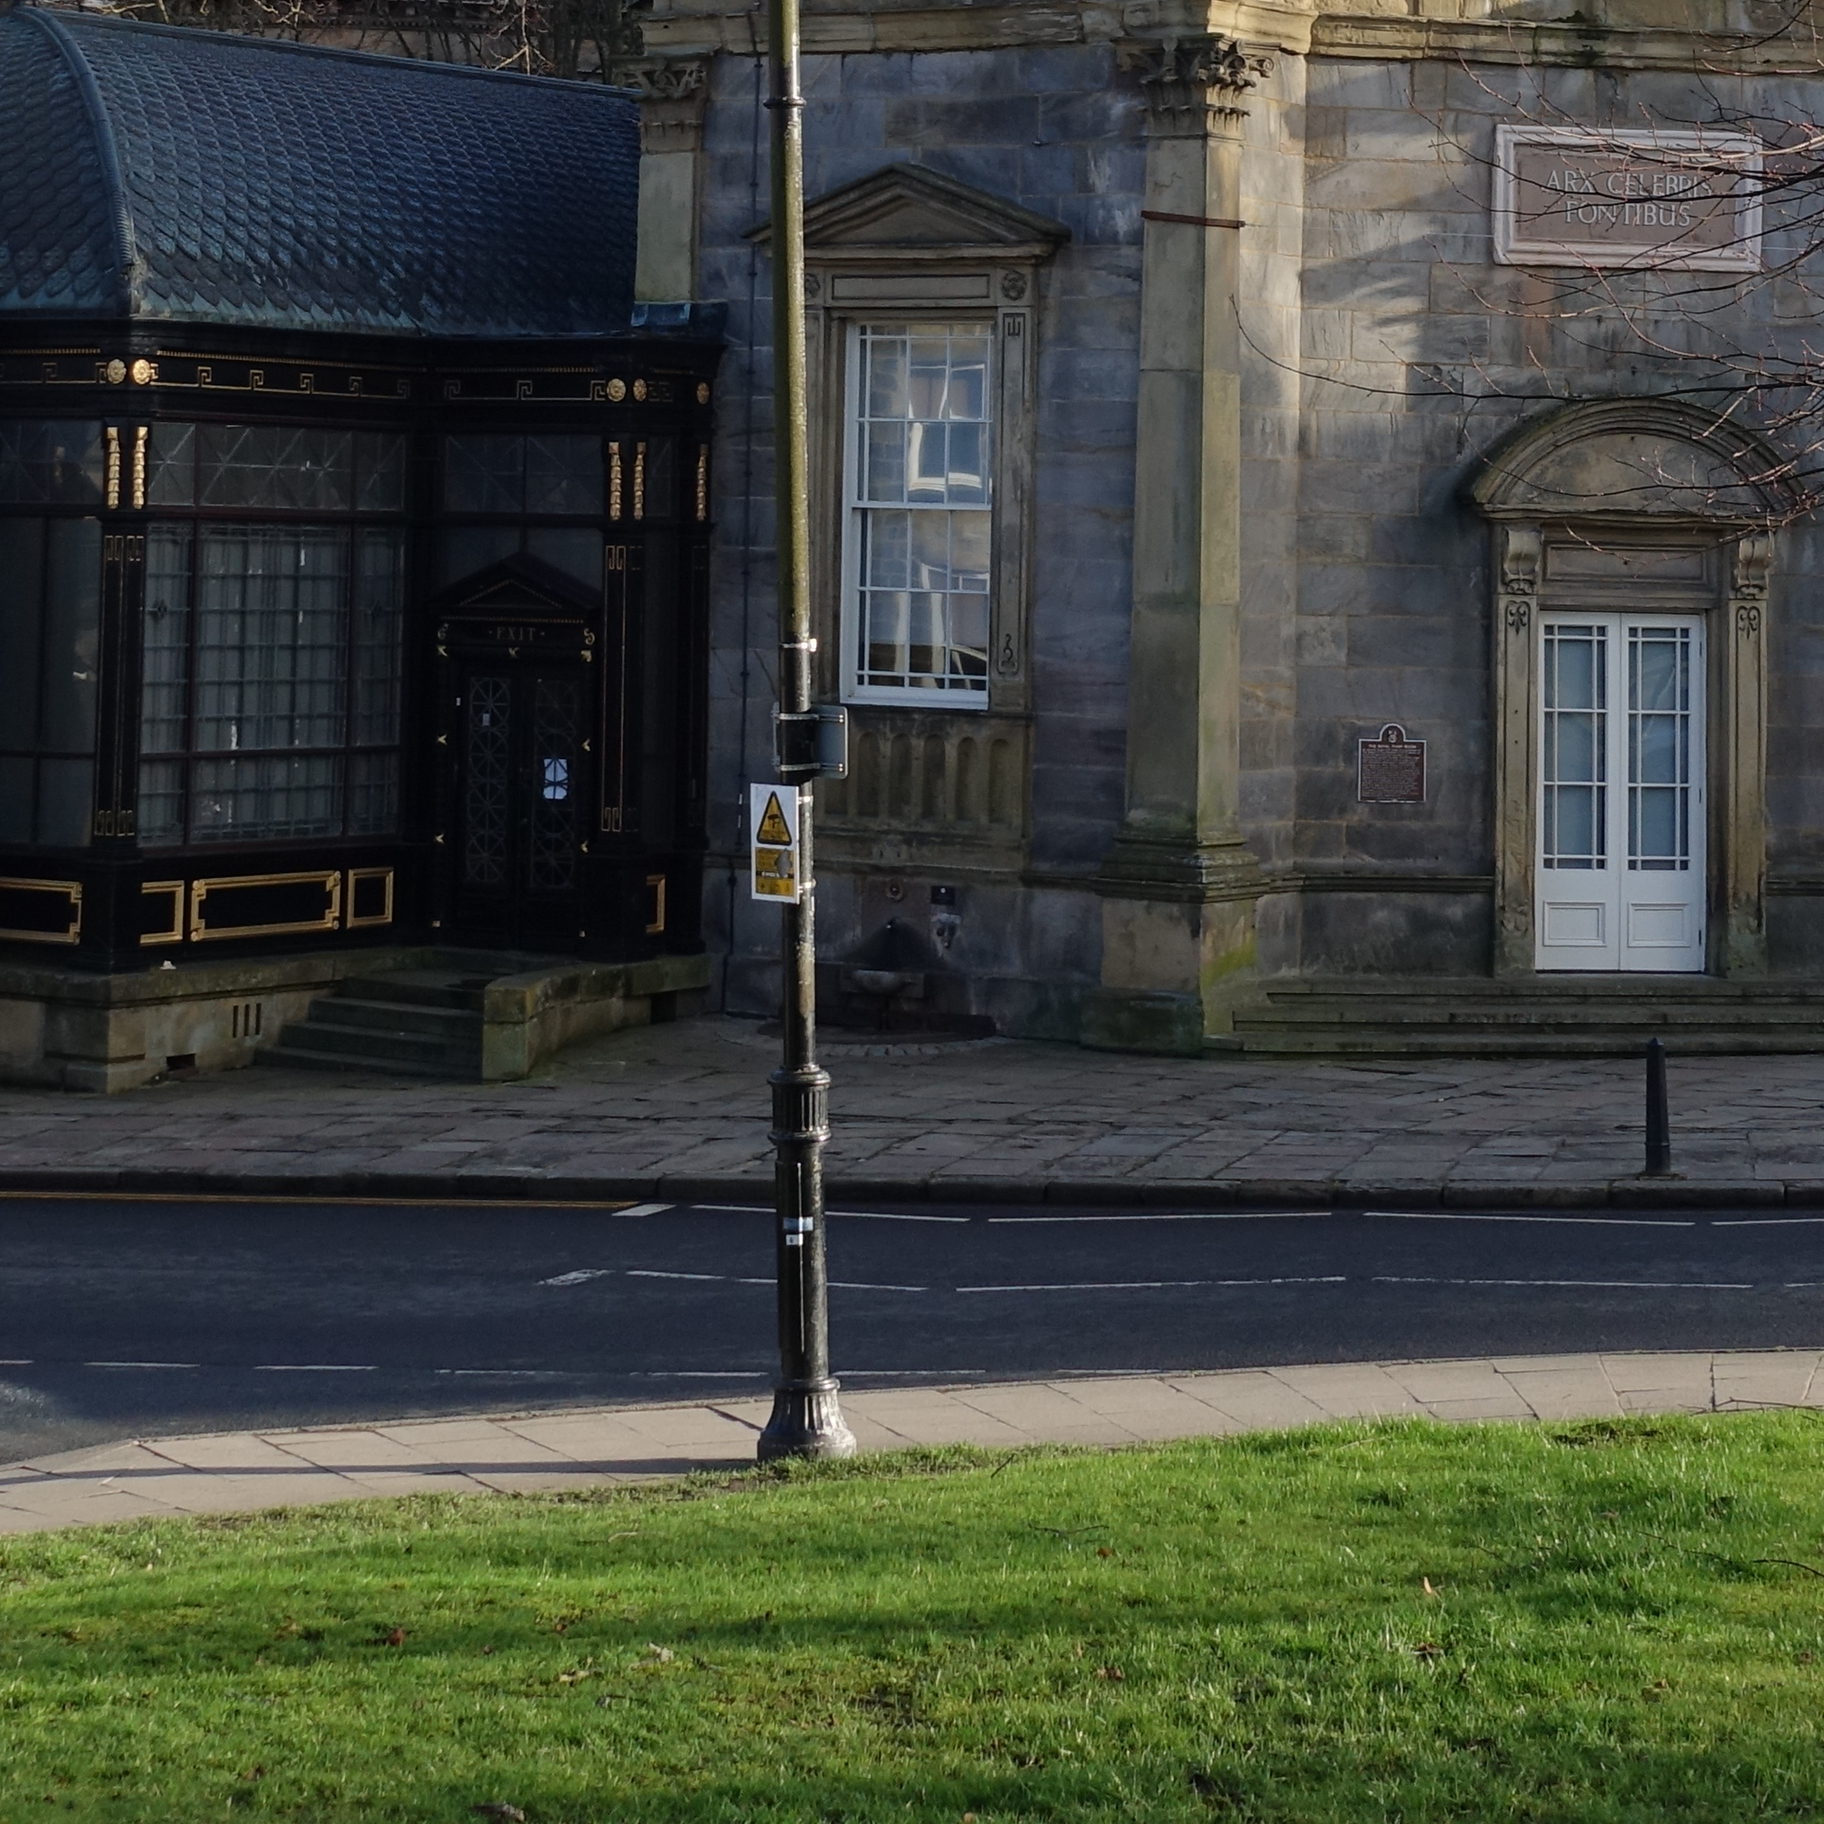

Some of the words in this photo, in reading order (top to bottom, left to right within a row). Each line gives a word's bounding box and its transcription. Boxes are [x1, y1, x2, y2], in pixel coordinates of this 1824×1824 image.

[1547, 170, 1595, 194] ARX
[1607, 173, 1712, 198] CELEBRIS
[1565, 201, 1694, 226] FONTIBUS
